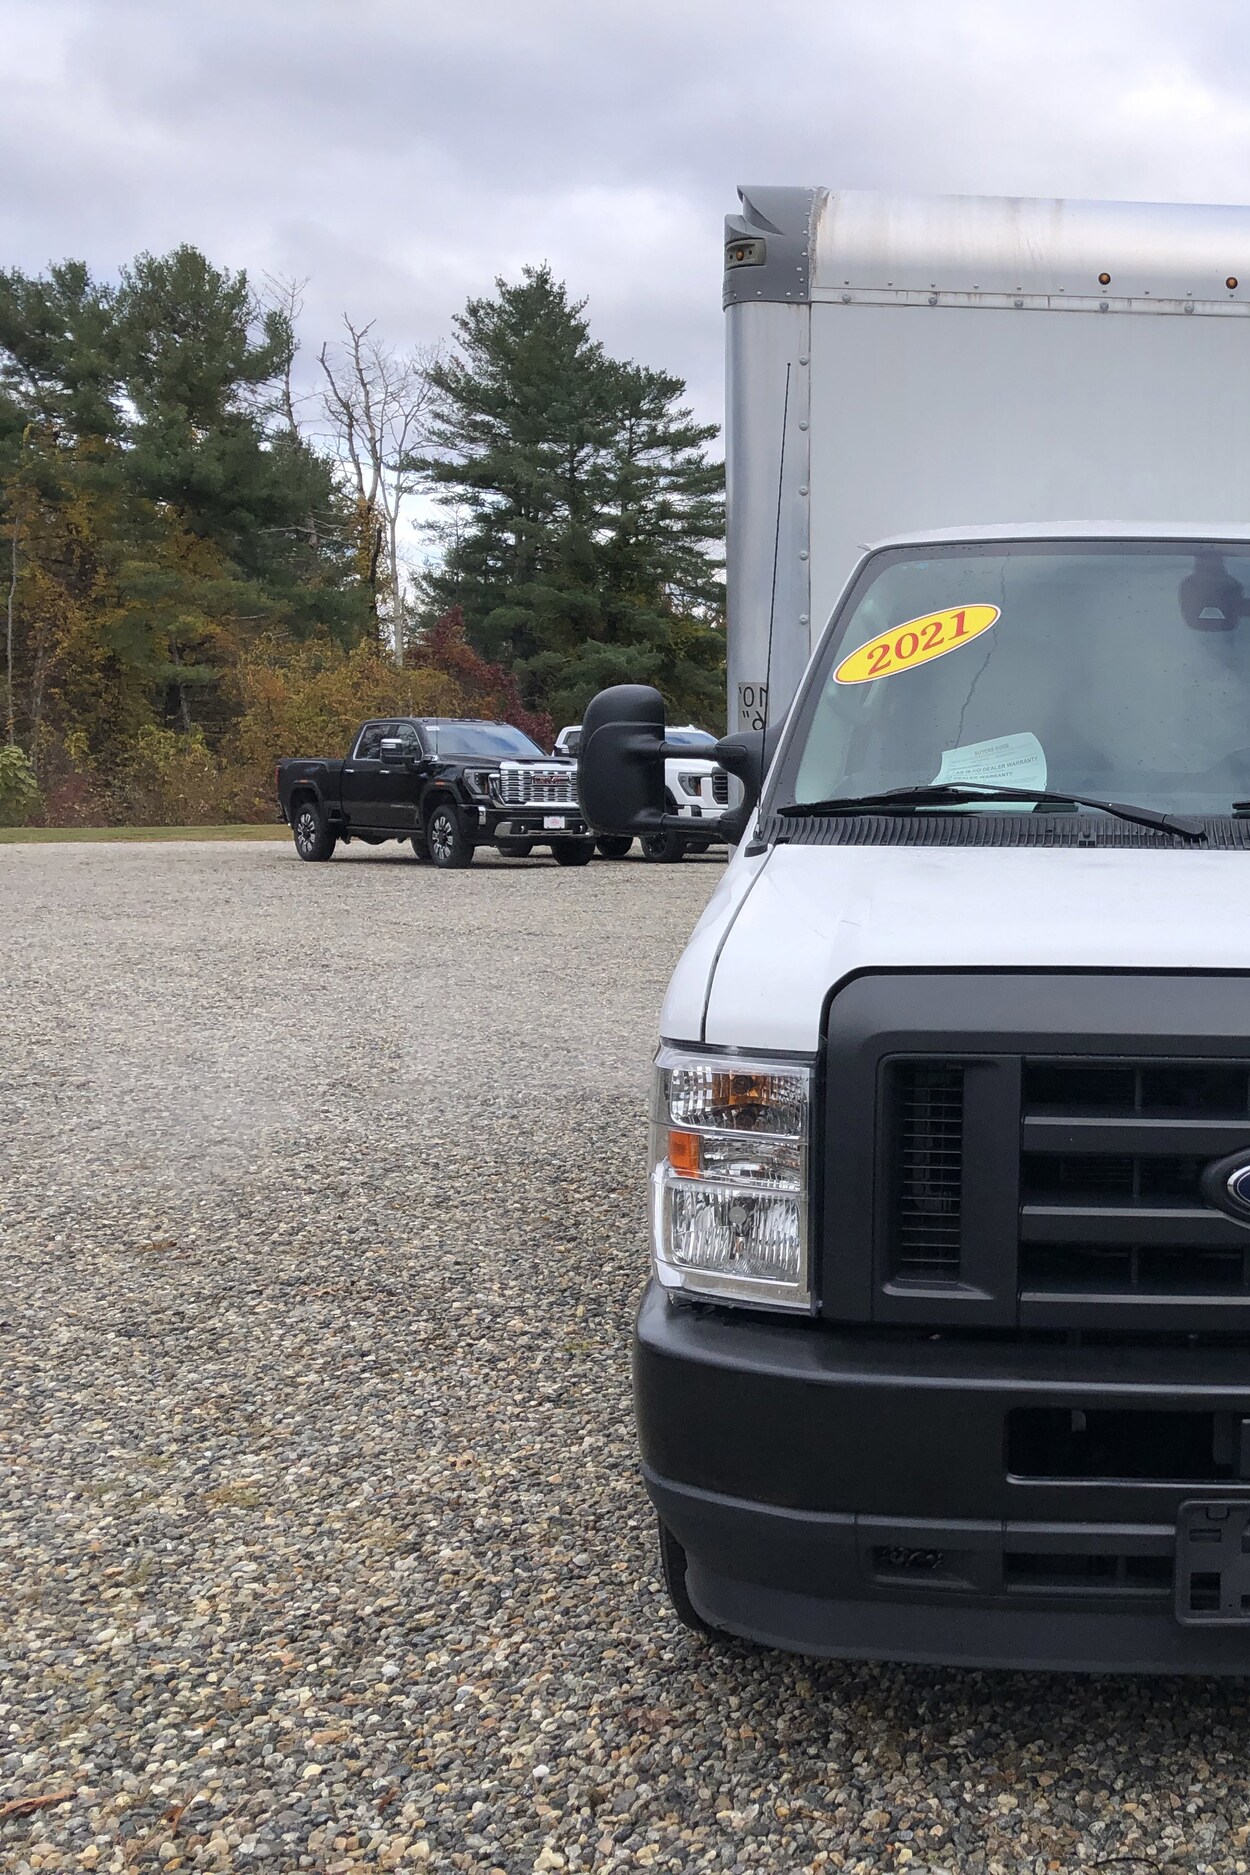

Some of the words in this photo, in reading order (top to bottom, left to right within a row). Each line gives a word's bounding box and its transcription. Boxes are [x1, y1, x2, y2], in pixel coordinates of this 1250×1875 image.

[866, 610, 970, 676] 2021
[982, 763, 1006, 772] DEALER
[1006, 756, 1038, 768] WARRANTY
